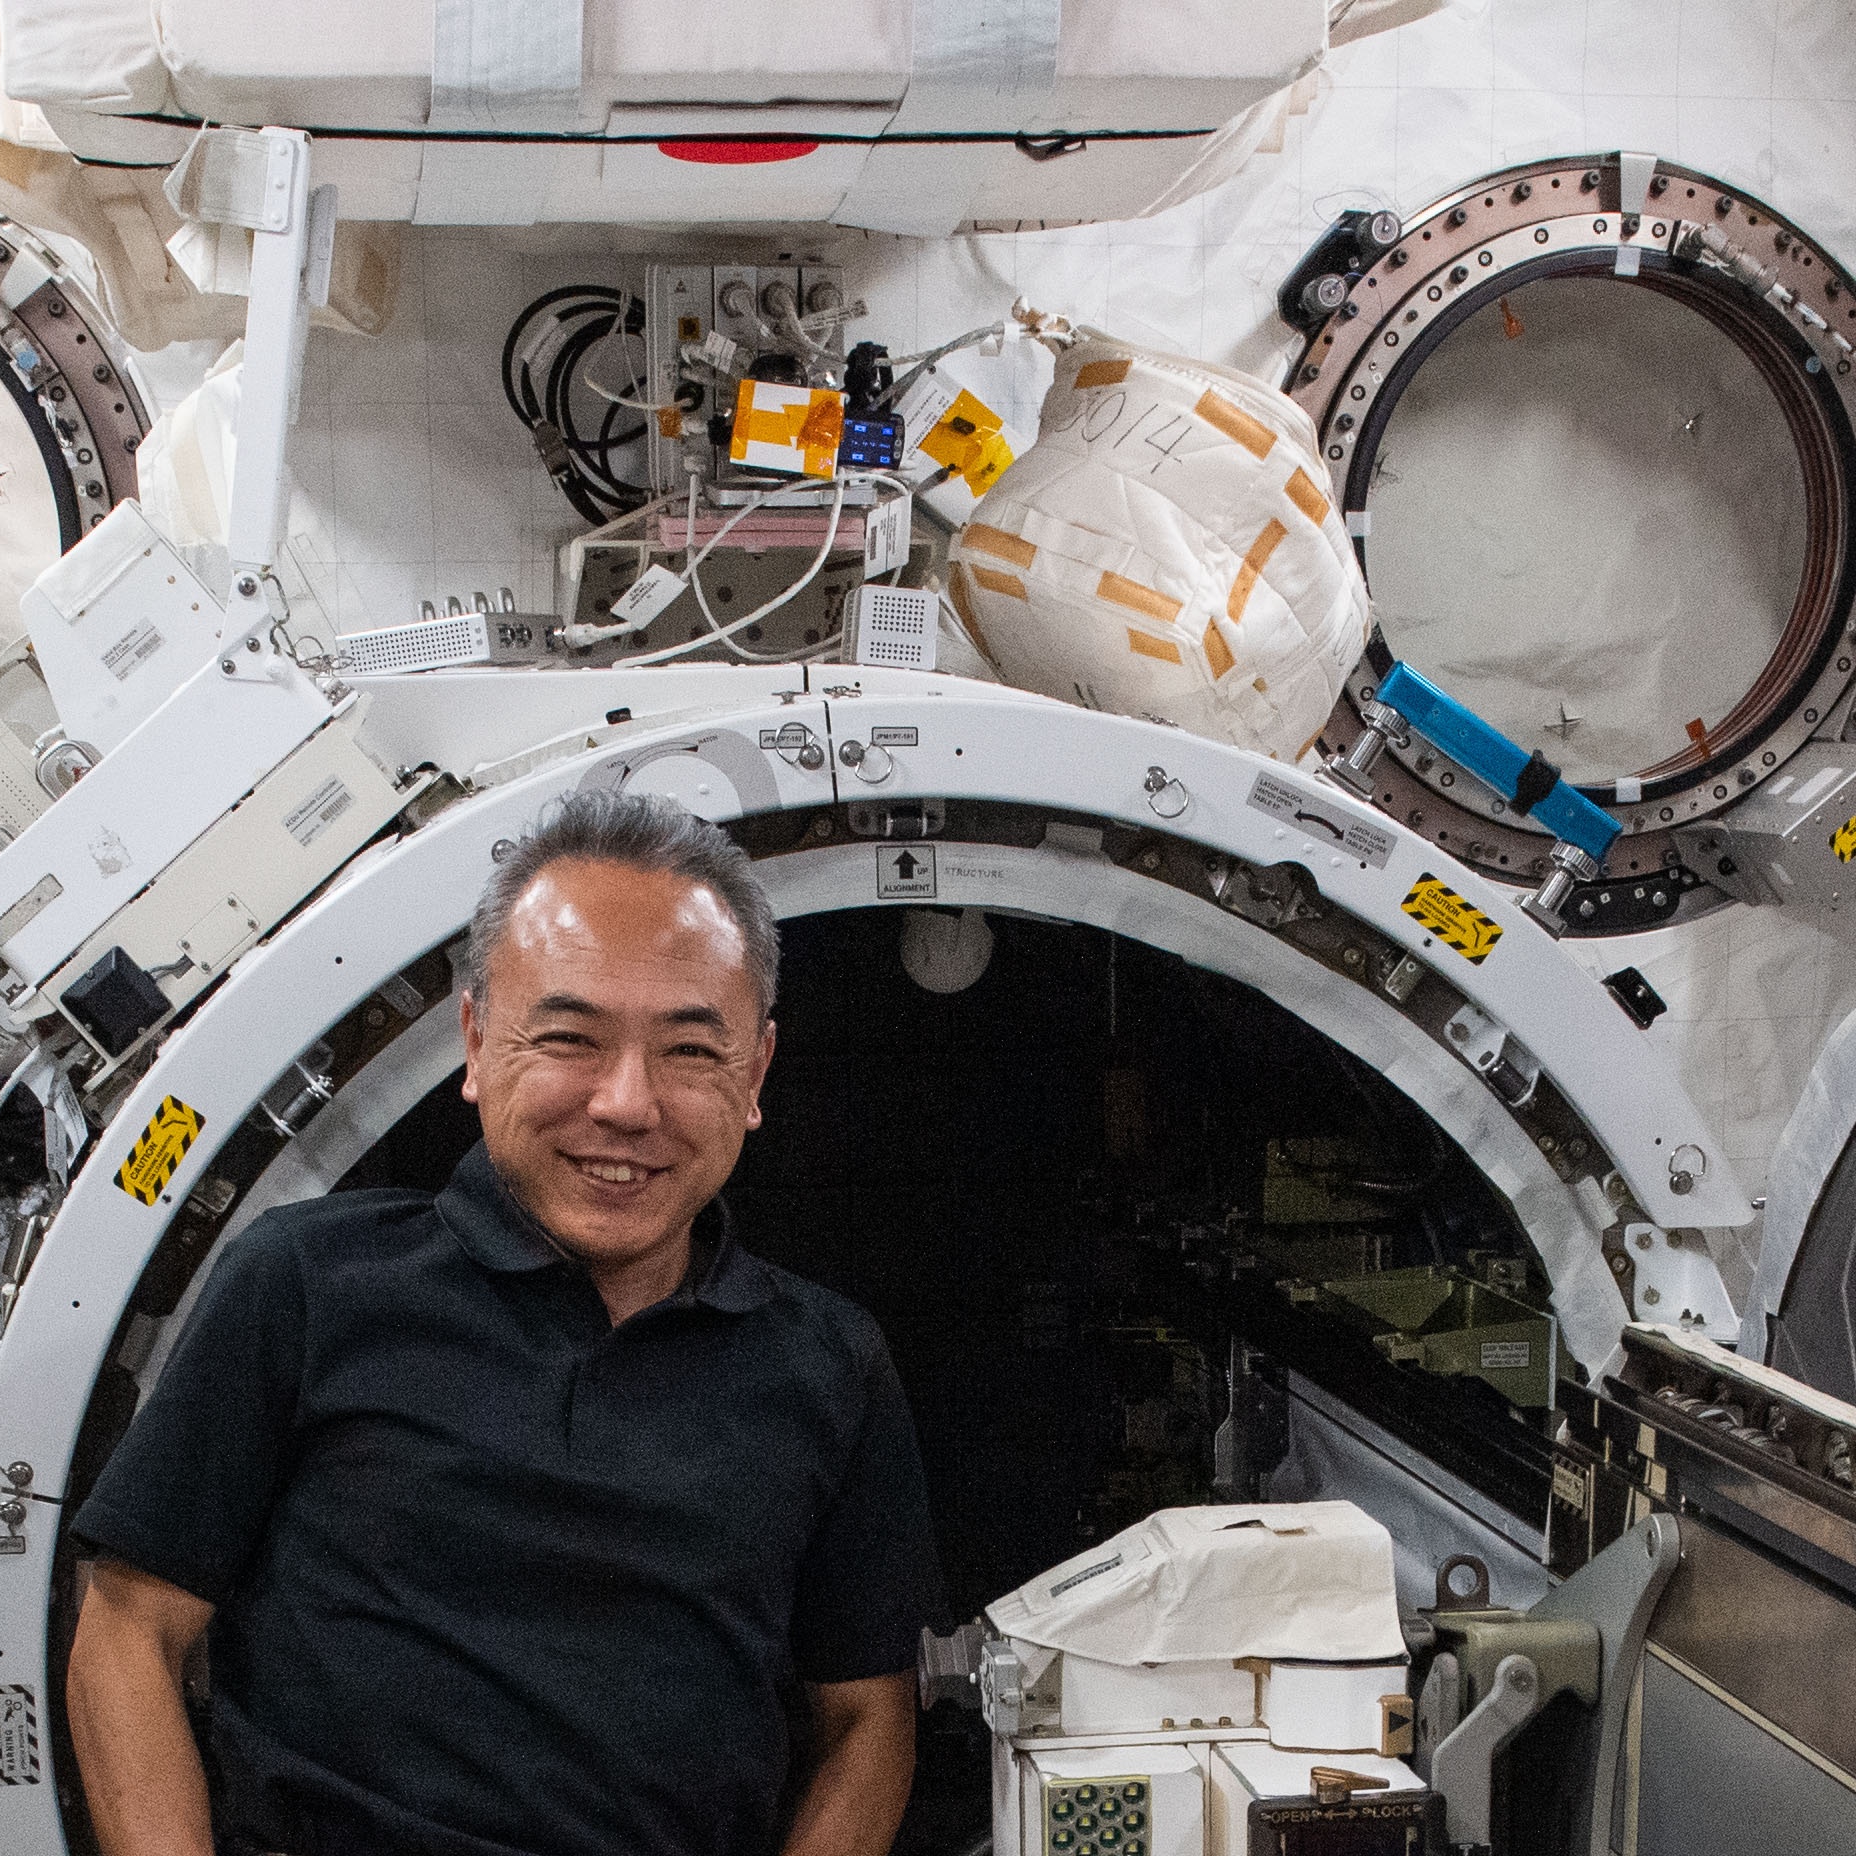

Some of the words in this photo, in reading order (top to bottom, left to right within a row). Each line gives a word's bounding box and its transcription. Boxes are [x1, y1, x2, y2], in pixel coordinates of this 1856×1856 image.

[1257, 786, 1276, 802] HATCH
[1275, 795, 1293, 809] OPEN
[1260, 779, 1280, 795] LATCH
[1279, 787, 1304, 804] UNLOCK
[1254, 793, 1271, 808] TABLE
[285, 814, 299, 828] ACDU
[1350, 822, 1369, 837] LATCH
[1348, 830, 1366, 846] HATCH
[917, 867, 929, 876] UP
[944, 866, 1003, 879] STRUCTURE
[883, 883, 931, 893] ALIGNMENT
[1425, 889, 1462, 918] CAUTION
[129, 1141, 159, 1181] CAUTION
[4, 1729, 15, 1772] WARNING
[1271, 1810, 1311, 1824] OPEN
[1373, 1805, 1413, 1818] LOCK
